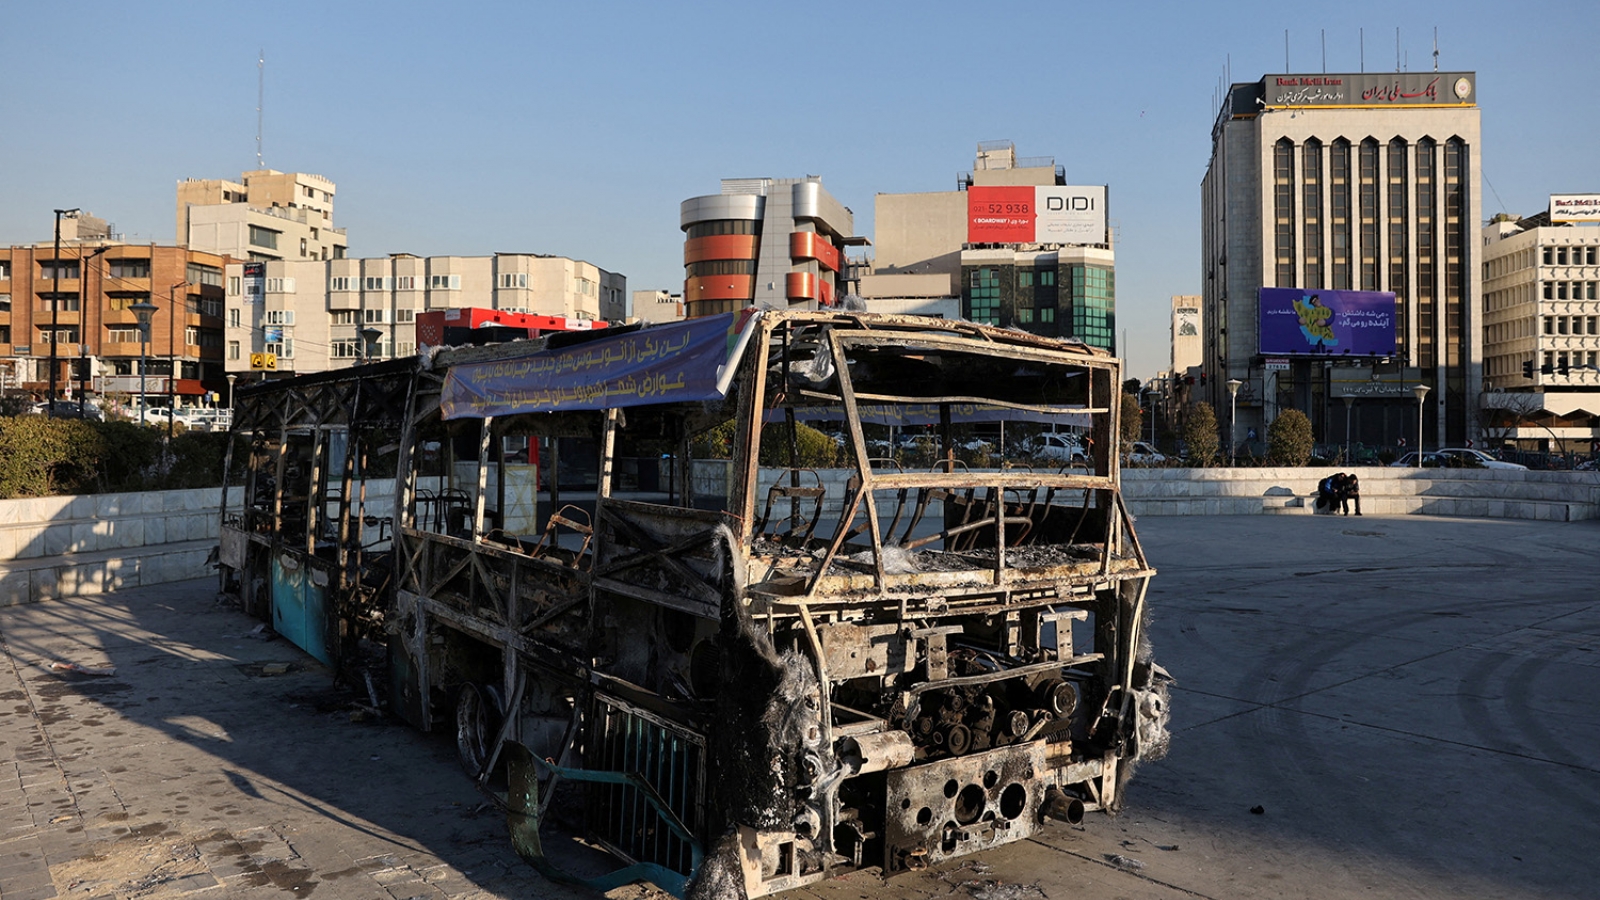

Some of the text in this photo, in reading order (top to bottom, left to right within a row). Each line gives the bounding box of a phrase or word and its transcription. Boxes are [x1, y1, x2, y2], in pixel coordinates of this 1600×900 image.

[1361, 77, 1440, 102] بانک ملی ایران
[988, 204, 1003, 214] 52
[1005, 204, 1029, 214] 938
[1047, 196, 1094, 211] DIDI
[627, 339, 636, 364] از
[637, 336, 658, 363] یکی
[659, 330, 690, 358] این
[494, 362, 504, 377] که
[531, 357, 555, 377] جدید
[552, 379, 604, 406] شهروندان
[604, 375, 637, 396] شما
[638, 371, 685, 398] عوارض
